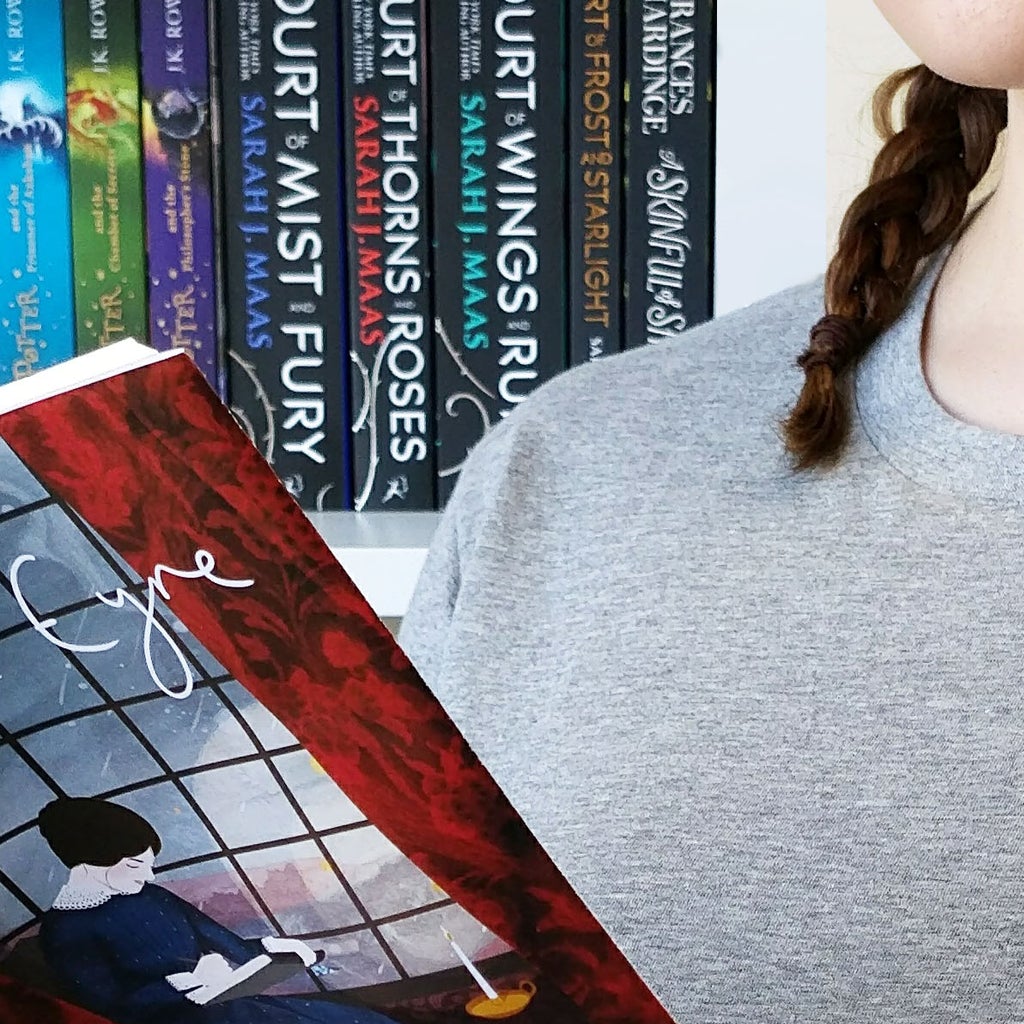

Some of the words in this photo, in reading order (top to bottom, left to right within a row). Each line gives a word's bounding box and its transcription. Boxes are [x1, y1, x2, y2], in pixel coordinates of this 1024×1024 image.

[495, 0, 535, 109] URT
[584, 50, 610, 149] FROST
[642, 0, 667, 134] ARDINGE
[242, 96, 267, 212] SARAH
[354, 97, 380, 214] SARAH
[381, 103, 421, 294] THORNS
[462, 95, 486, 212] SARAH
[277, 155, 322, 295] MIST
[497, 131, 537, 312] WINGS
[584, 168, 610, 328] STARLIGHT
[246, 252, 271, 348] MAAS
[360, 249, 383, 344] MAAS
[463, 252, 488, 349] MAAS
[281, 325, 325, 463] FURY
[386, 315, 426, 461] ROSES
[499, 337, 541, 419] RU
[10, 550, 255, 699] Eyre
